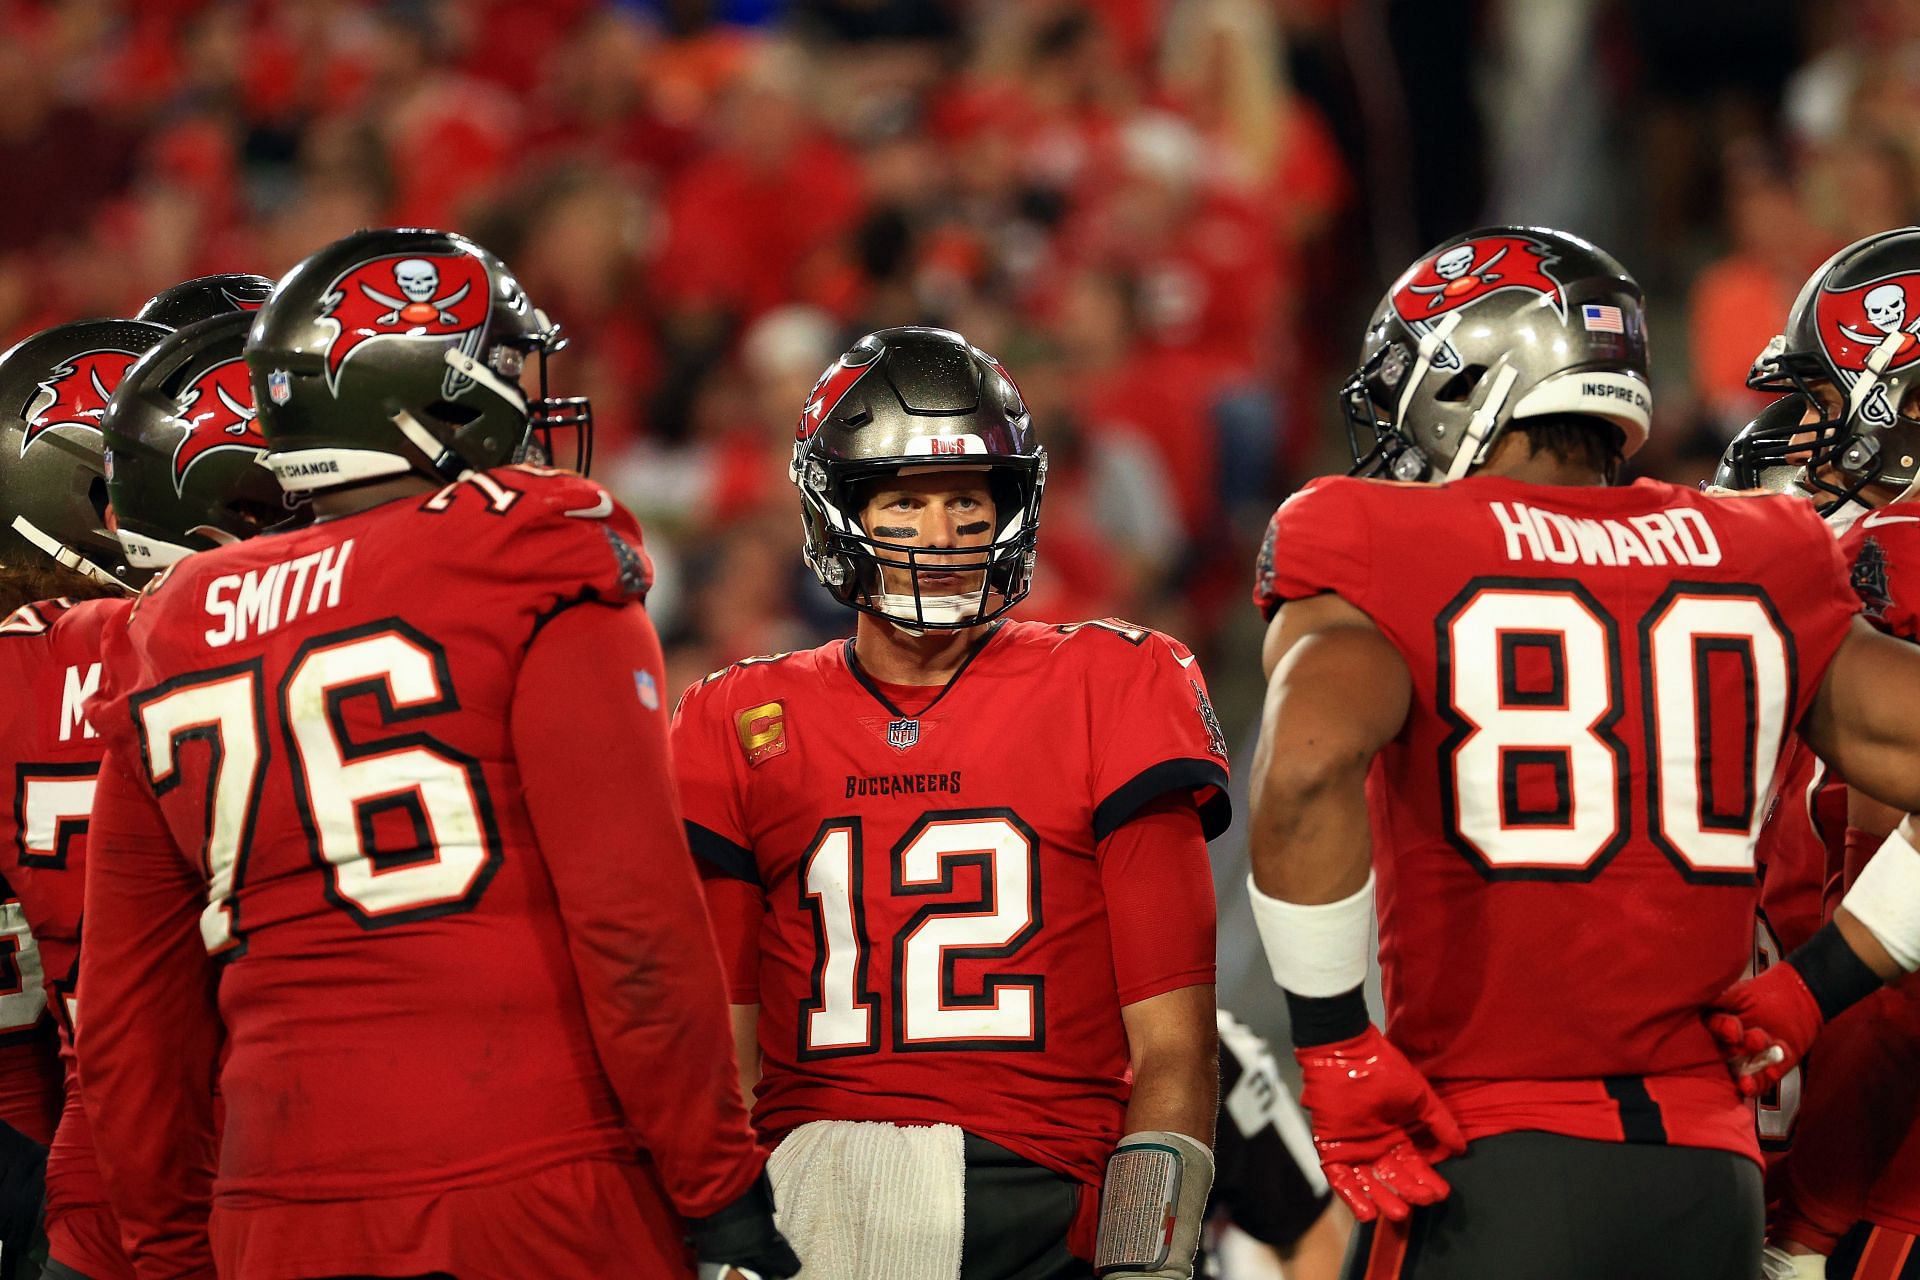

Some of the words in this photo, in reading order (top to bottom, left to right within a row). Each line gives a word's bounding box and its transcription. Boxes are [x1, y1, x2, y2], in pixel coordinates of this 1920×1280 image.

[1582, 383, 1633, 403] INSPIRE
[286, 460, 339, 479] CHANGE
[931, 438, 966, 455] BUCS
[1489, 501, 1722, 567] HOWARD
[204, 538, 355, 648] SMITH
[891, 729, 914, 743] NFL
[1434, 575, 1797, 887] 80
[129, 615, 505, 963] 76
[845, 770, 962, 800] BUCCANEERS
[796, 806, 1046, 1063] 12
